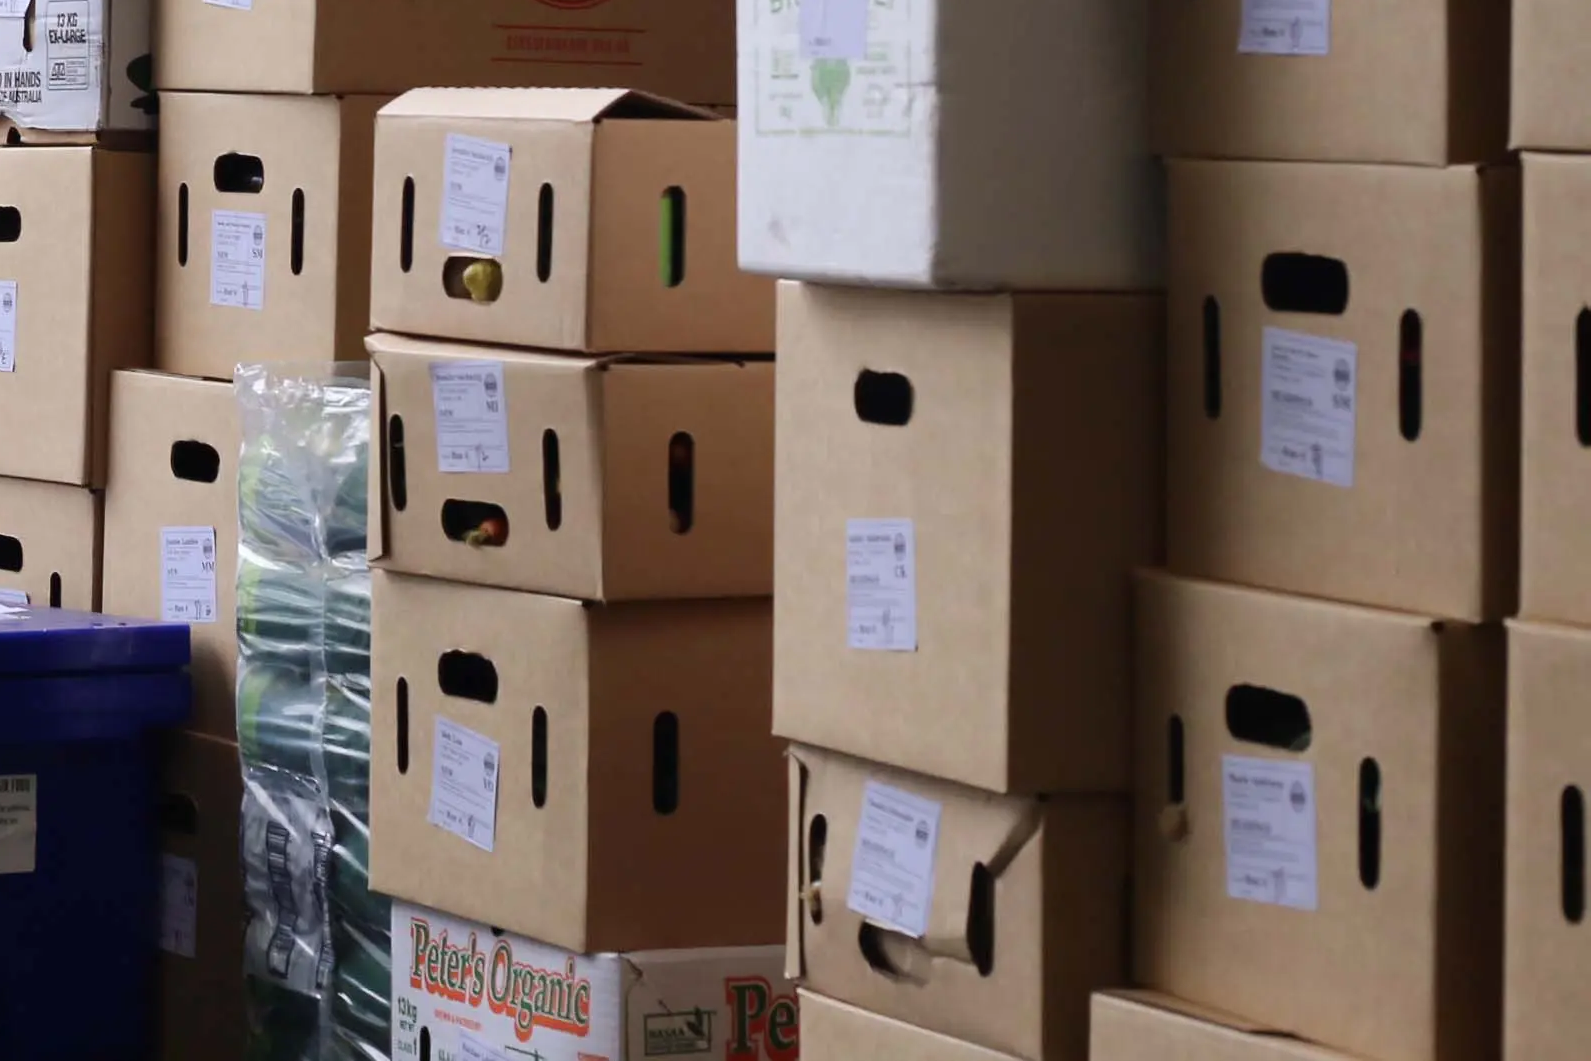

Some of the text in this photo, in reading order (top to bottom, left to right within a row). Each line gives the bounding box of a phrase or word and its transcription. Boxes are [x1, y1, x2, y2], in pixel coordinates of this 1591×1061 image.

[66, 12, 78, 27] KG
[4, 72, 13, 88] IN
[14, 70, 41, 88] HANDS
[9, 90, 42, 104] AUSTRALIA
[410, 917, 591, 1041] Peter's Organic
[397, 995, 417, 1024] 13kg
